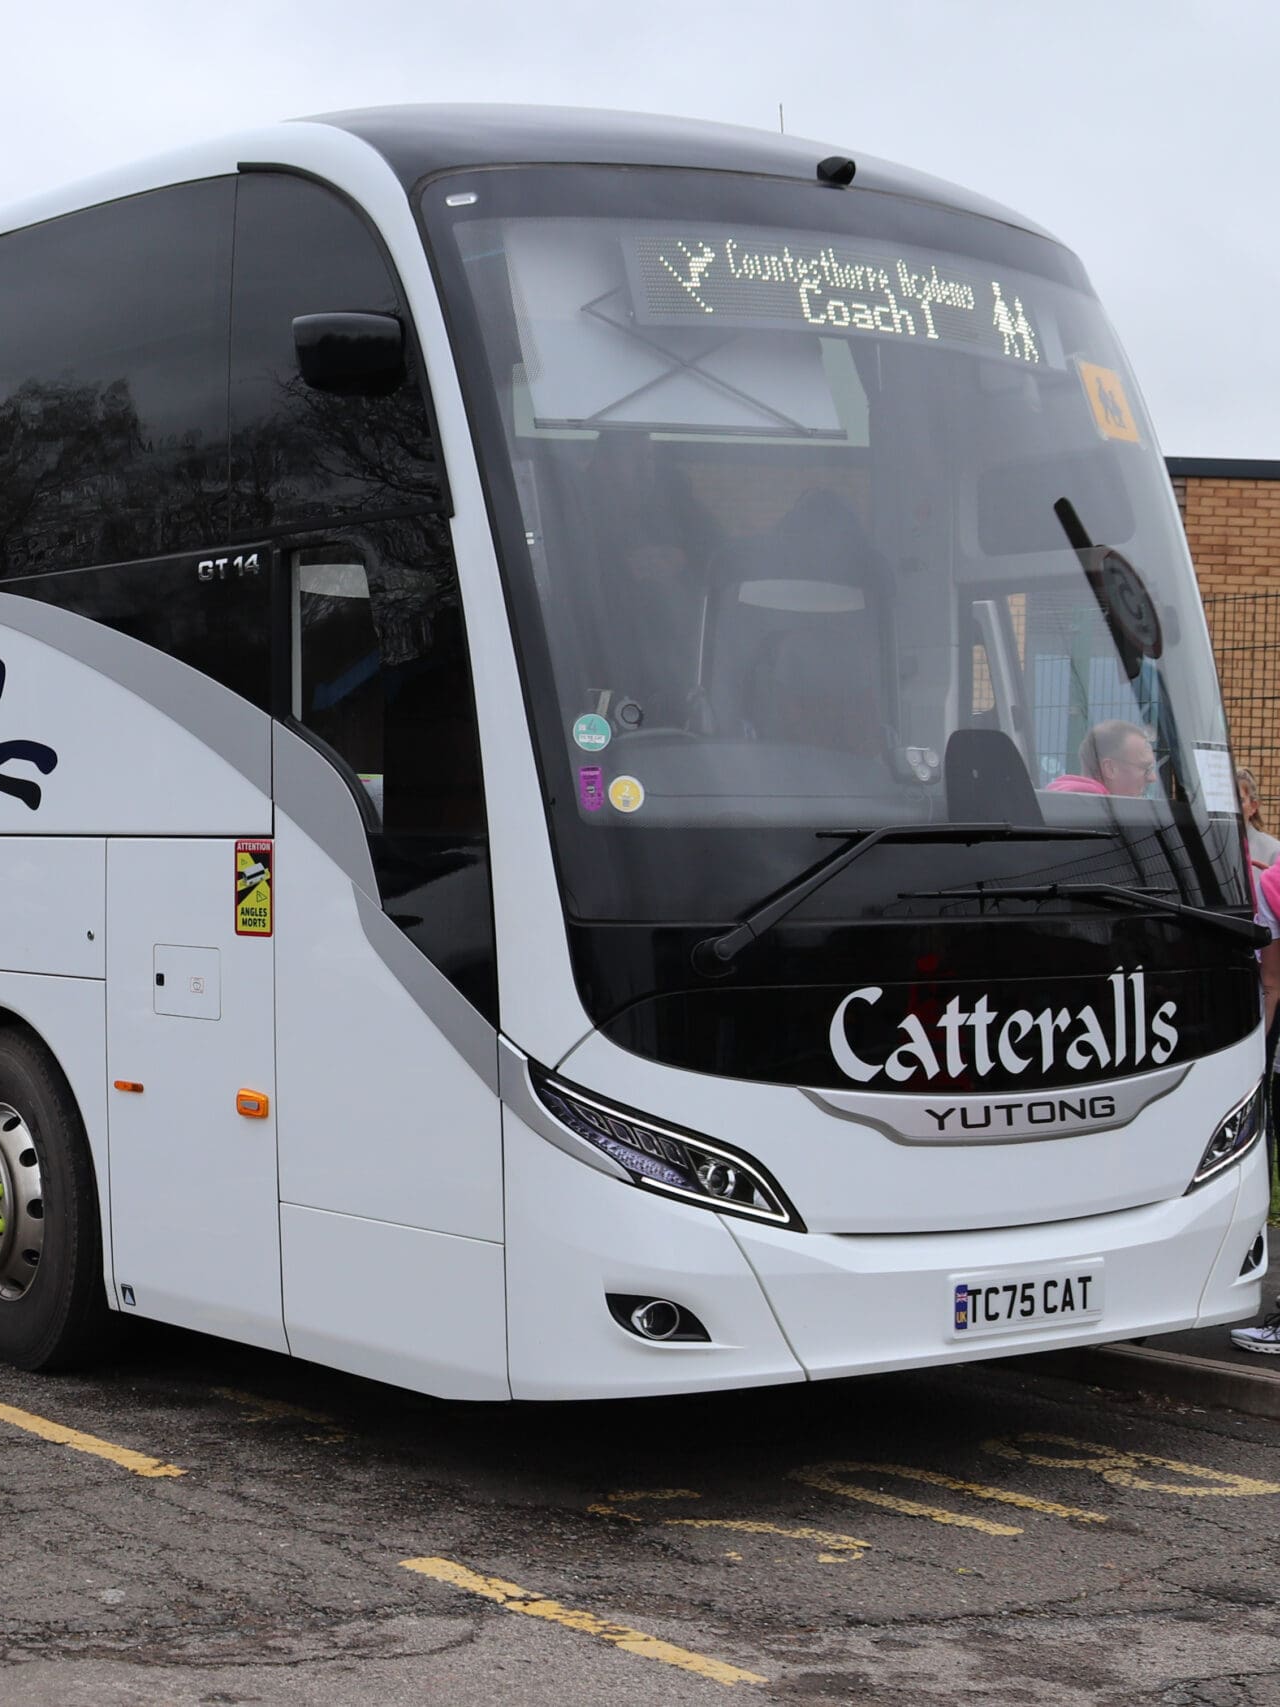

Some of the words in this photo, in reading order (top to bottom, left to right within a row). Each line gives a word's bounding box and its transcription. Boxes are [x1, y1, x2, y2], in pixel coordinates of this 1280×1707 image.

[798, 279, 917, 335] Coach
[198, 558, 228, 581] GT
[233, 553, 259, 577] 14
[237, 842, 271, 851] ATTENTION
[241, 907, 267, 917] ANGLES
[242, 918, 266, 928] MORTS
[829, 965, 1179, 1083] Catteralls
[924, 1096, 1116, 1131] YUTONG
[967, 1282, 1035, 1323] TC75
[1043, 1276, 1092, 1314] CAT
[956, 1311, 967, 1323] UK
